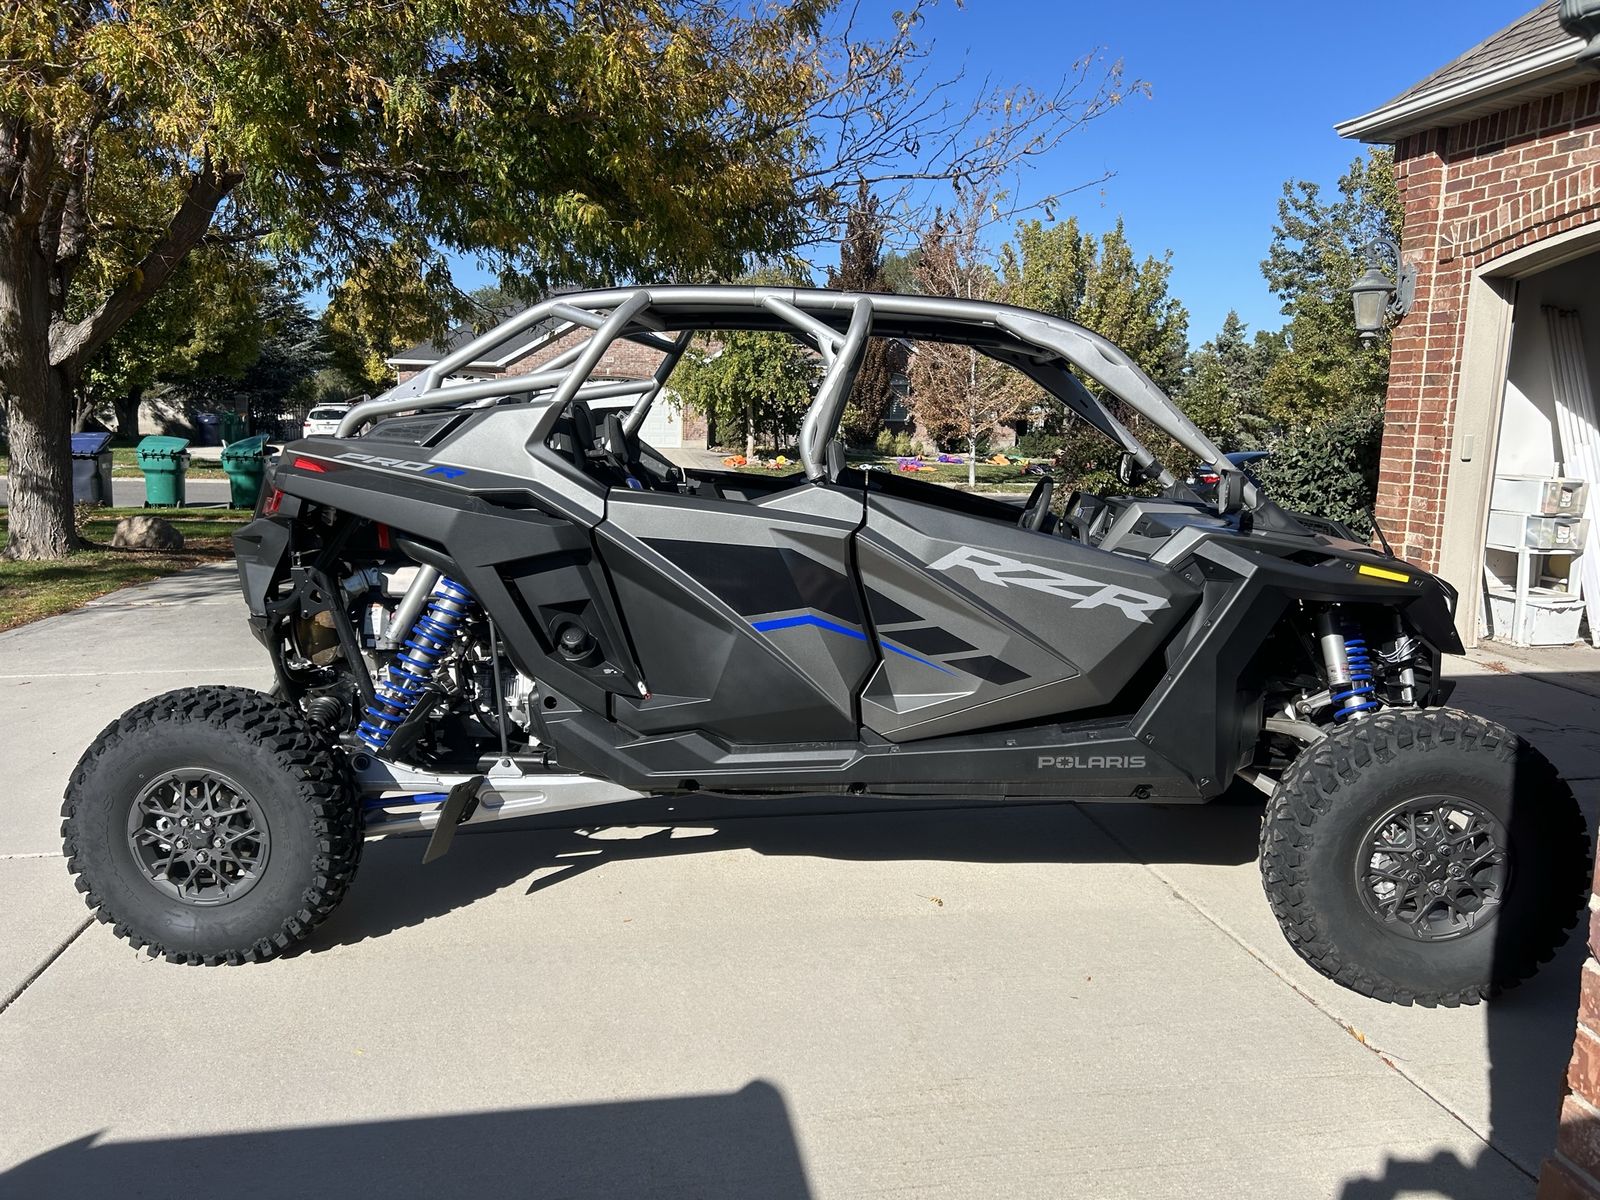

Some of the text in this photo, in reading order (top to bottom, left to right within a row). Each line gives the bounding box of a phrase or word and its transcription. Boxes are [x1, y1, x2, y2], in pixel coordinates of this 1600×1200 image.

[334, 453, 467, 479] PRO R
[925, 546, 1171, 624] RZR
[1037, 755, 1147, 769] POLARIS
